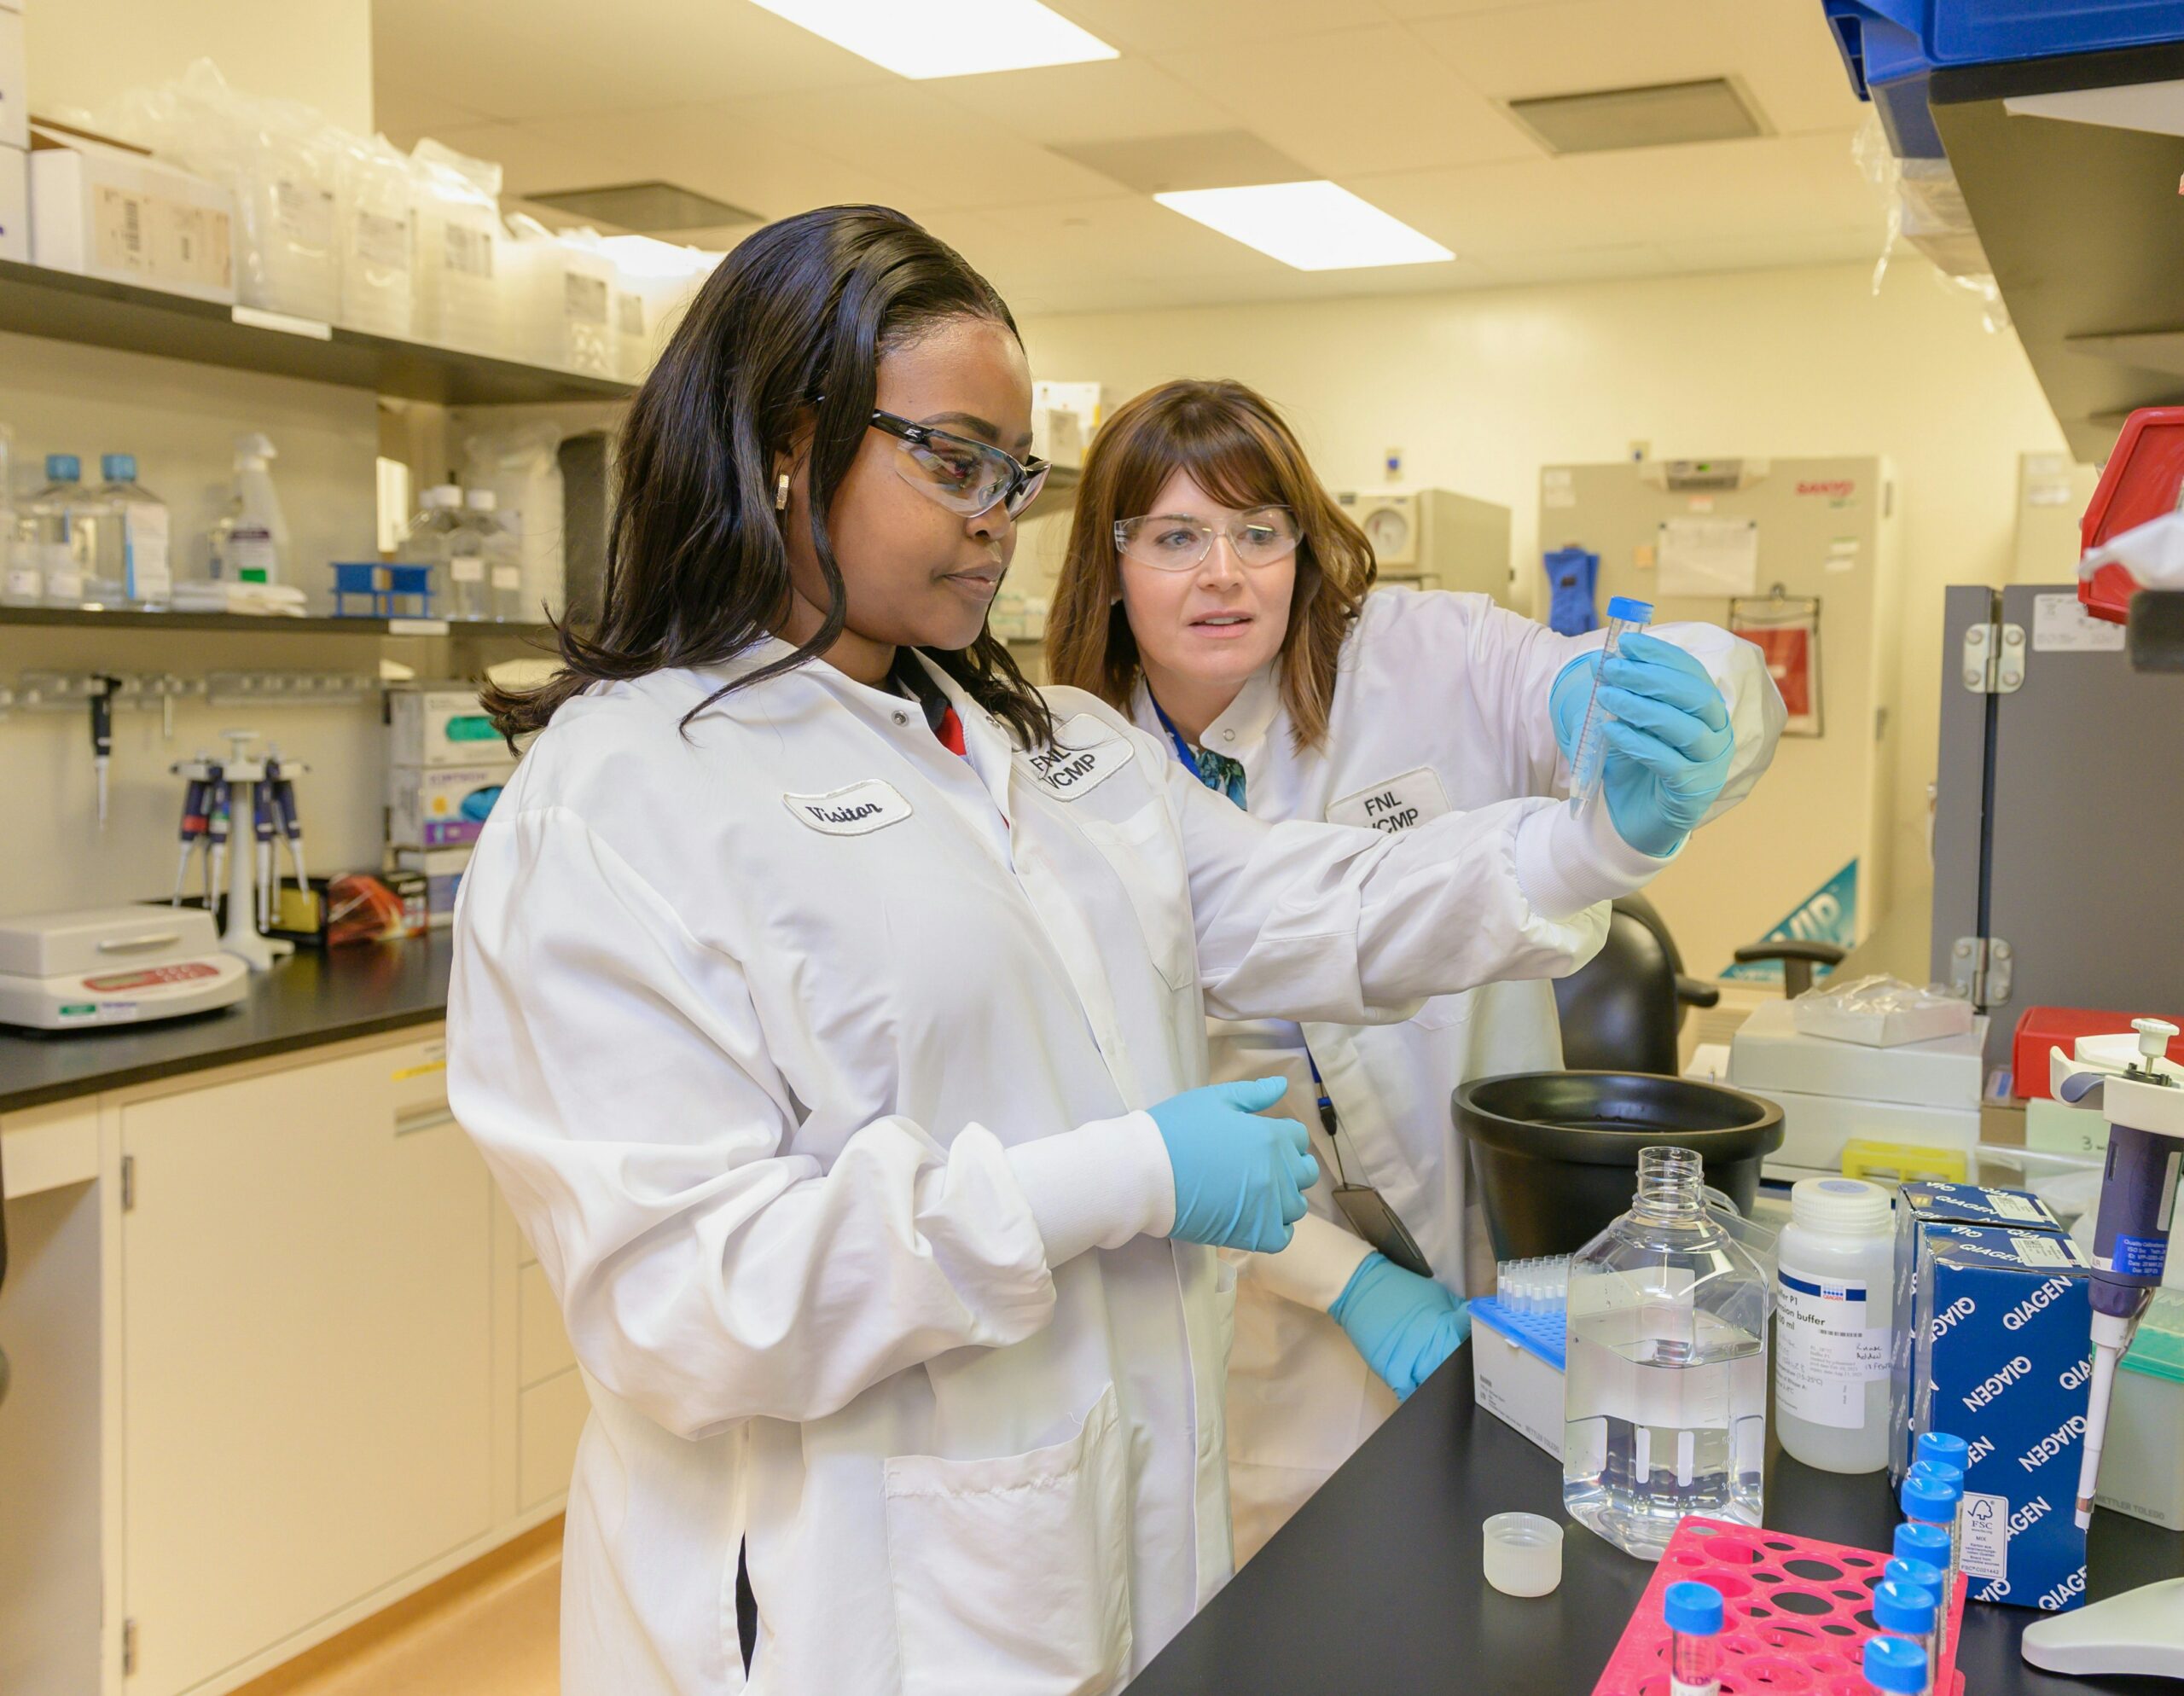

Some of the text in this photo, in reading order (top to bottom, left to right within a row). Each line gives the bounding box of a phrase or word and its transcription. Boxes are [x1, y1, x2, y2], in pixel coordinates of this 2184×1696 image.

[1030, 748, 1072, 771] FNL
[805, 803, 883, 823] Visitor
[1364, 791, 1402, 816] FNL
[1372, 808, 1419, 833] CMP
[1790, 1295, 1798, 1305] P1
[2003, 1275, 2073, 1330] QIAGEN
[1797, 1310, 1826, 1326] buffer
[1931, 1297, 1976, 1344] QIAG
[1962, 1356, 2032, 1413] QIAGEN
[2059, 1353, 2093, 1391] QIA
[2018, 1415, 2088, 1472] QIAGEN
[1972, 1520, 1993, 1530] FSC
[2133, 1505, 2165, 1520] TOLEDO
